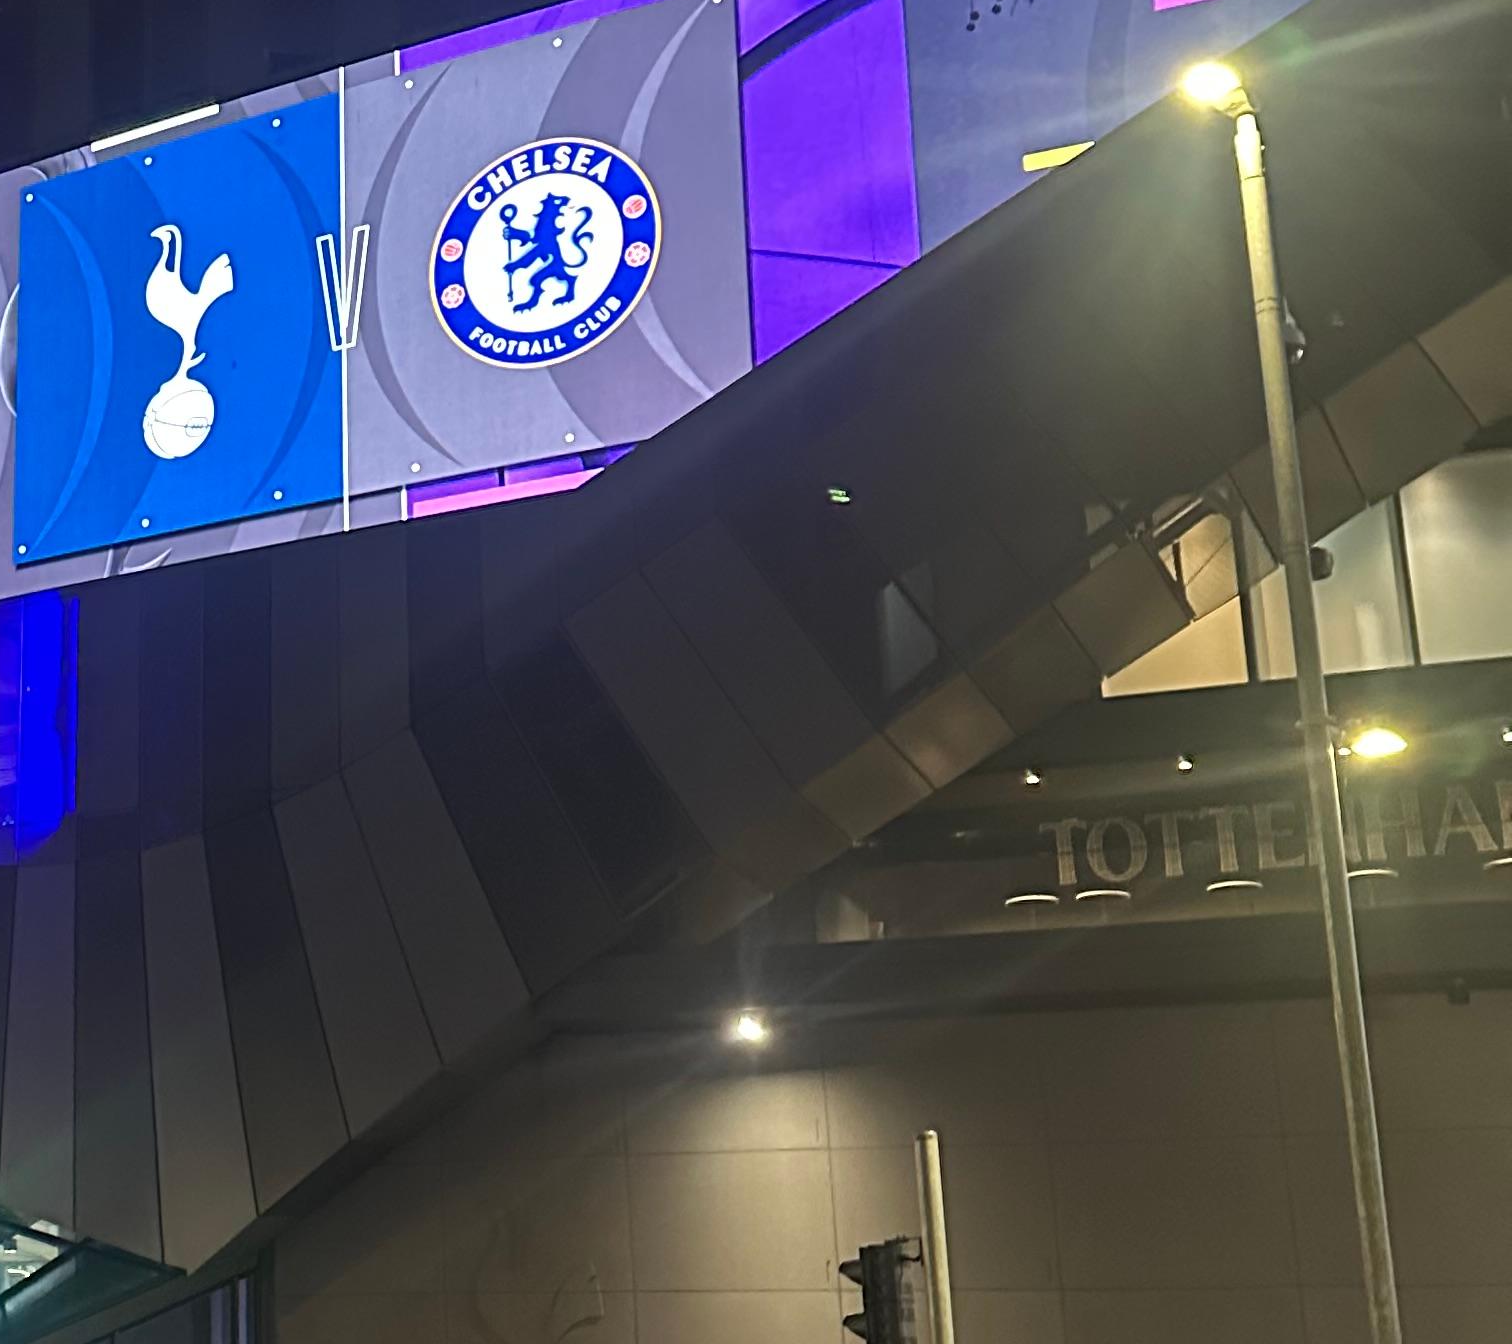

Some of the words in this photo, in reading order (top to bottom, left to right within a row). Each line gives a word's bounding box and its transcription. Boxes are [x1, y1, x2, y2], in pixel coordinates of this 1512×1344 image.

[467, 144, 612, 212] CHELSEA
[469, 325, 567, 357] FOOTBALL
[574, 294, 623, 341] CLUB
